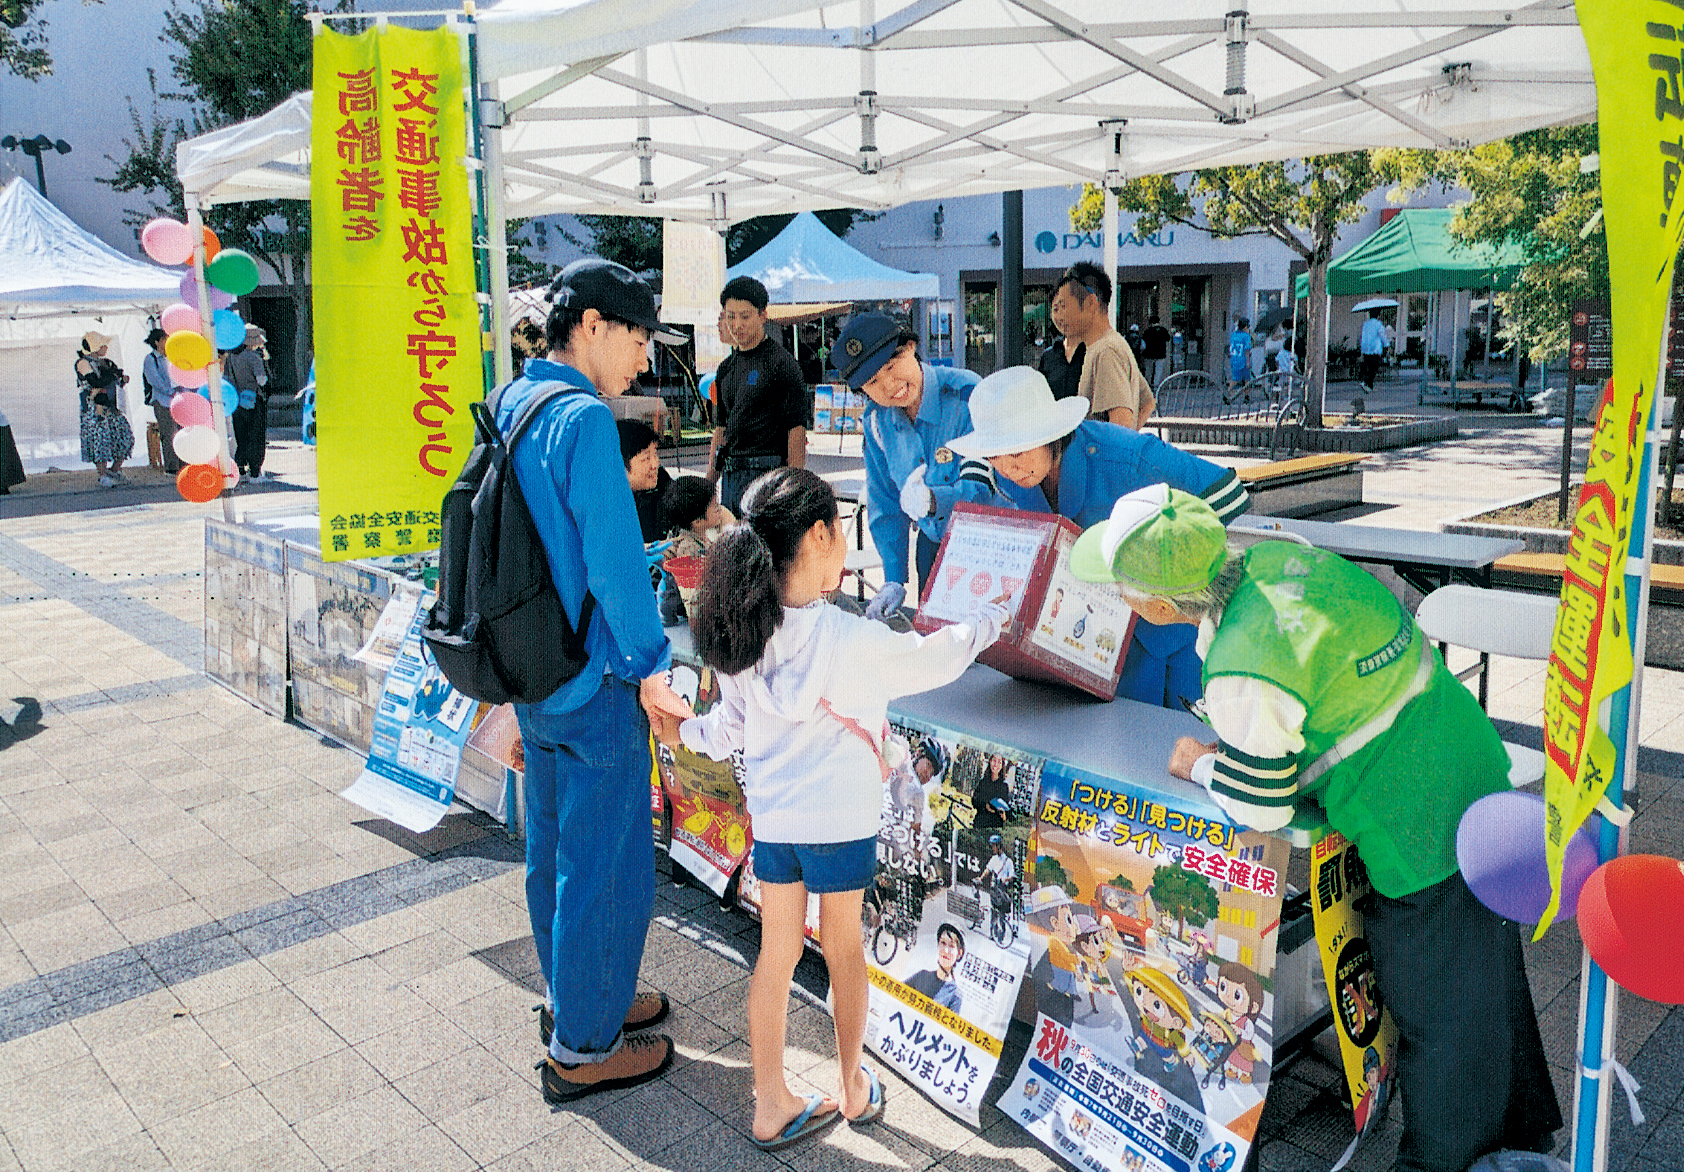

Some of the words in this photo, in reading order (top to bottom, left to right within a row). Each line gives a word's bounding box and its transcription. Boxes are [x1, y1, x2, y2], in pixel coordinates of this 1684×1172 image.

[1070, 780, 1236, 850] 「つける」「見つける」
[880, 1035, 972, 1110] かぶりましょう。
[889, 1011, 978, 1083] ヘルメットを
[1036, 1018, 1200, 1161] 秋の全国交通安全運動
